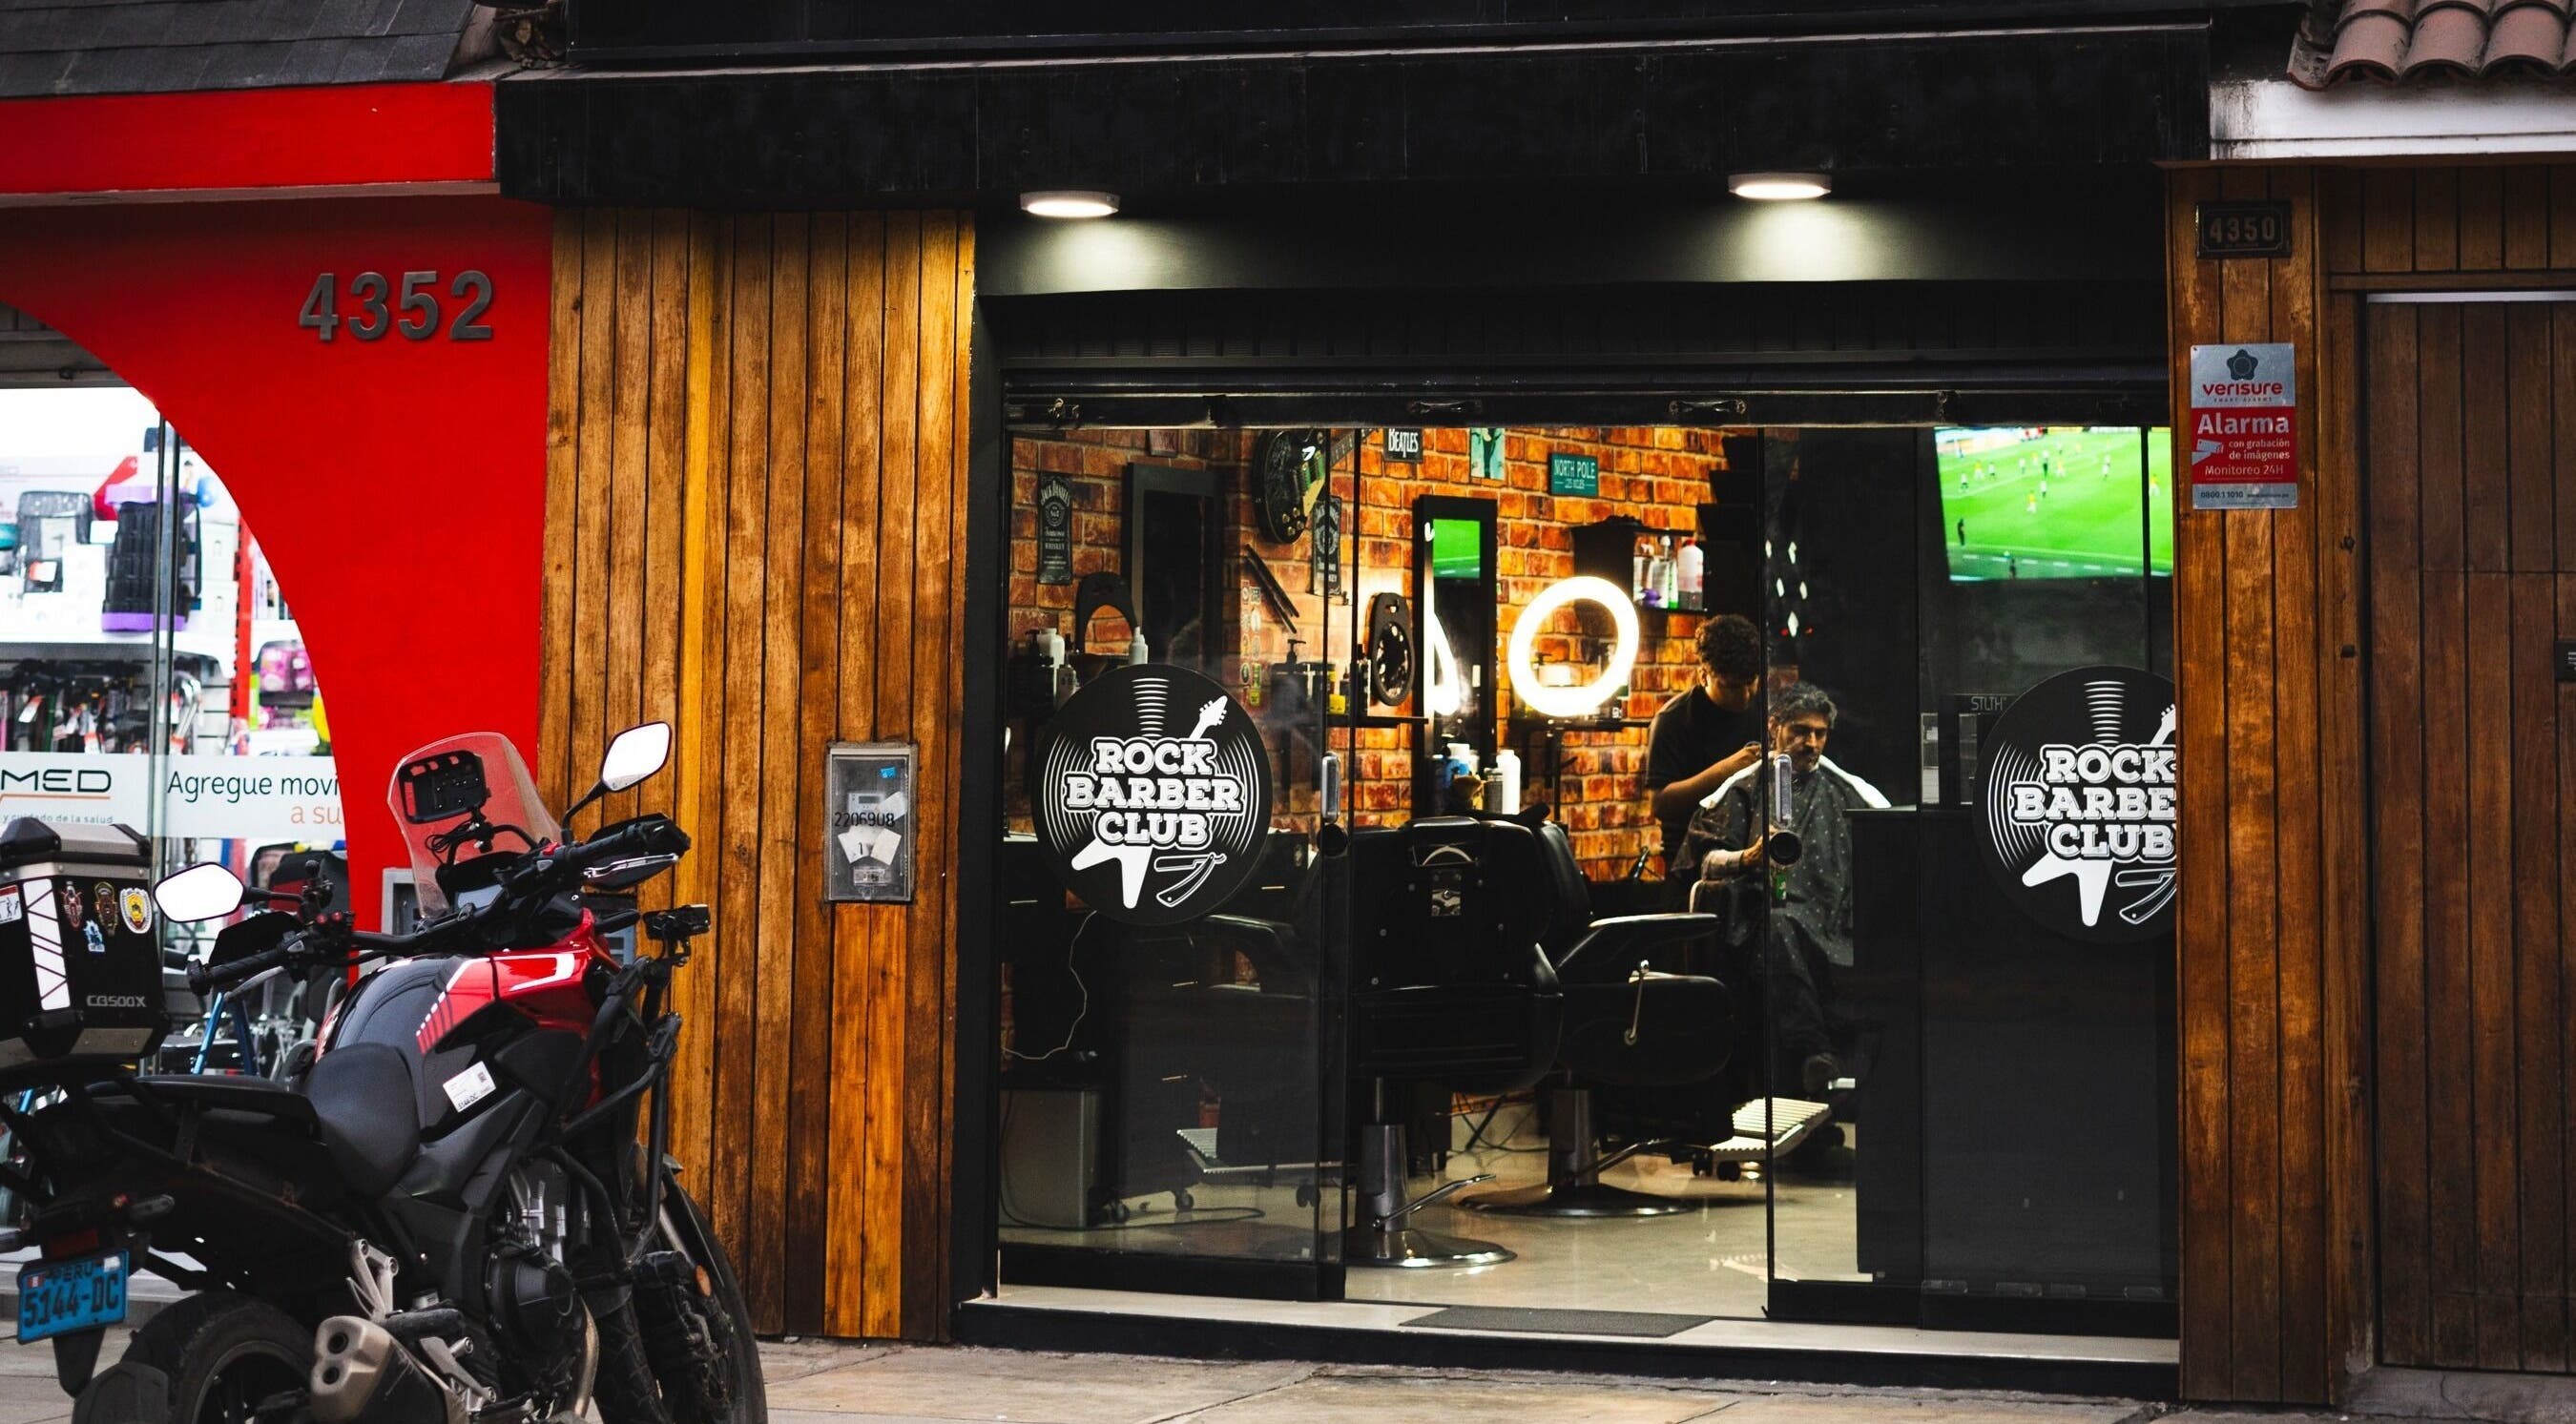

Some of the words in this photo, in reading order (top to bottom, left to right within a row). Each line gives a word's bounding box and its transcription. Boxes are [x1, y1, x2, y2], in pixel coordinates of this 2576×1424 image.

[2210, 217, 2275, 242] 4350
[299, 270, 492, 341] 4352
[2202, 382, 2283, 396] verisure
[2197, 412, 2290, 435] Alarma
[1388, 428, 1419, 458] BEATLES
[2246, 438, 2290, 449] grabación
[2229, 450, 2242, 459] de
[2244, 449, 2290, 462] imágenes
[1554, 460, 1574, 477] NORTH
[1577, 462, 1596, 479] POLE
[2205, 464, 2260, 476] Monitoreo
[2263, 464, 2284, 475] 24H
[1971, 695, 2003, 712] STLTH
[1095, 742, 1213, 775] ROCK
[2046, 749, 2176, 783] ROCK
[1, 769, 112, 793] MED
[167, 771, 272, 803] Agregue
[280, 773, 339, 795] movi
[1067, 776, 1241, 811] BARBER
[2014, 786, 2176, 820] BARBE
[55, 814, 69, 822] de
[290, 805, 305, 824] a
[313, 806, 342, 824] su
[834, 812, 896, 829] 2206908
[1097, 811, 1208, 845] CLUB
[2050, 822, 2175, 857] CLUB
[86, 995, 147, 1007] CB500X
[23, 1272, 119, 1329] 5144-DC
